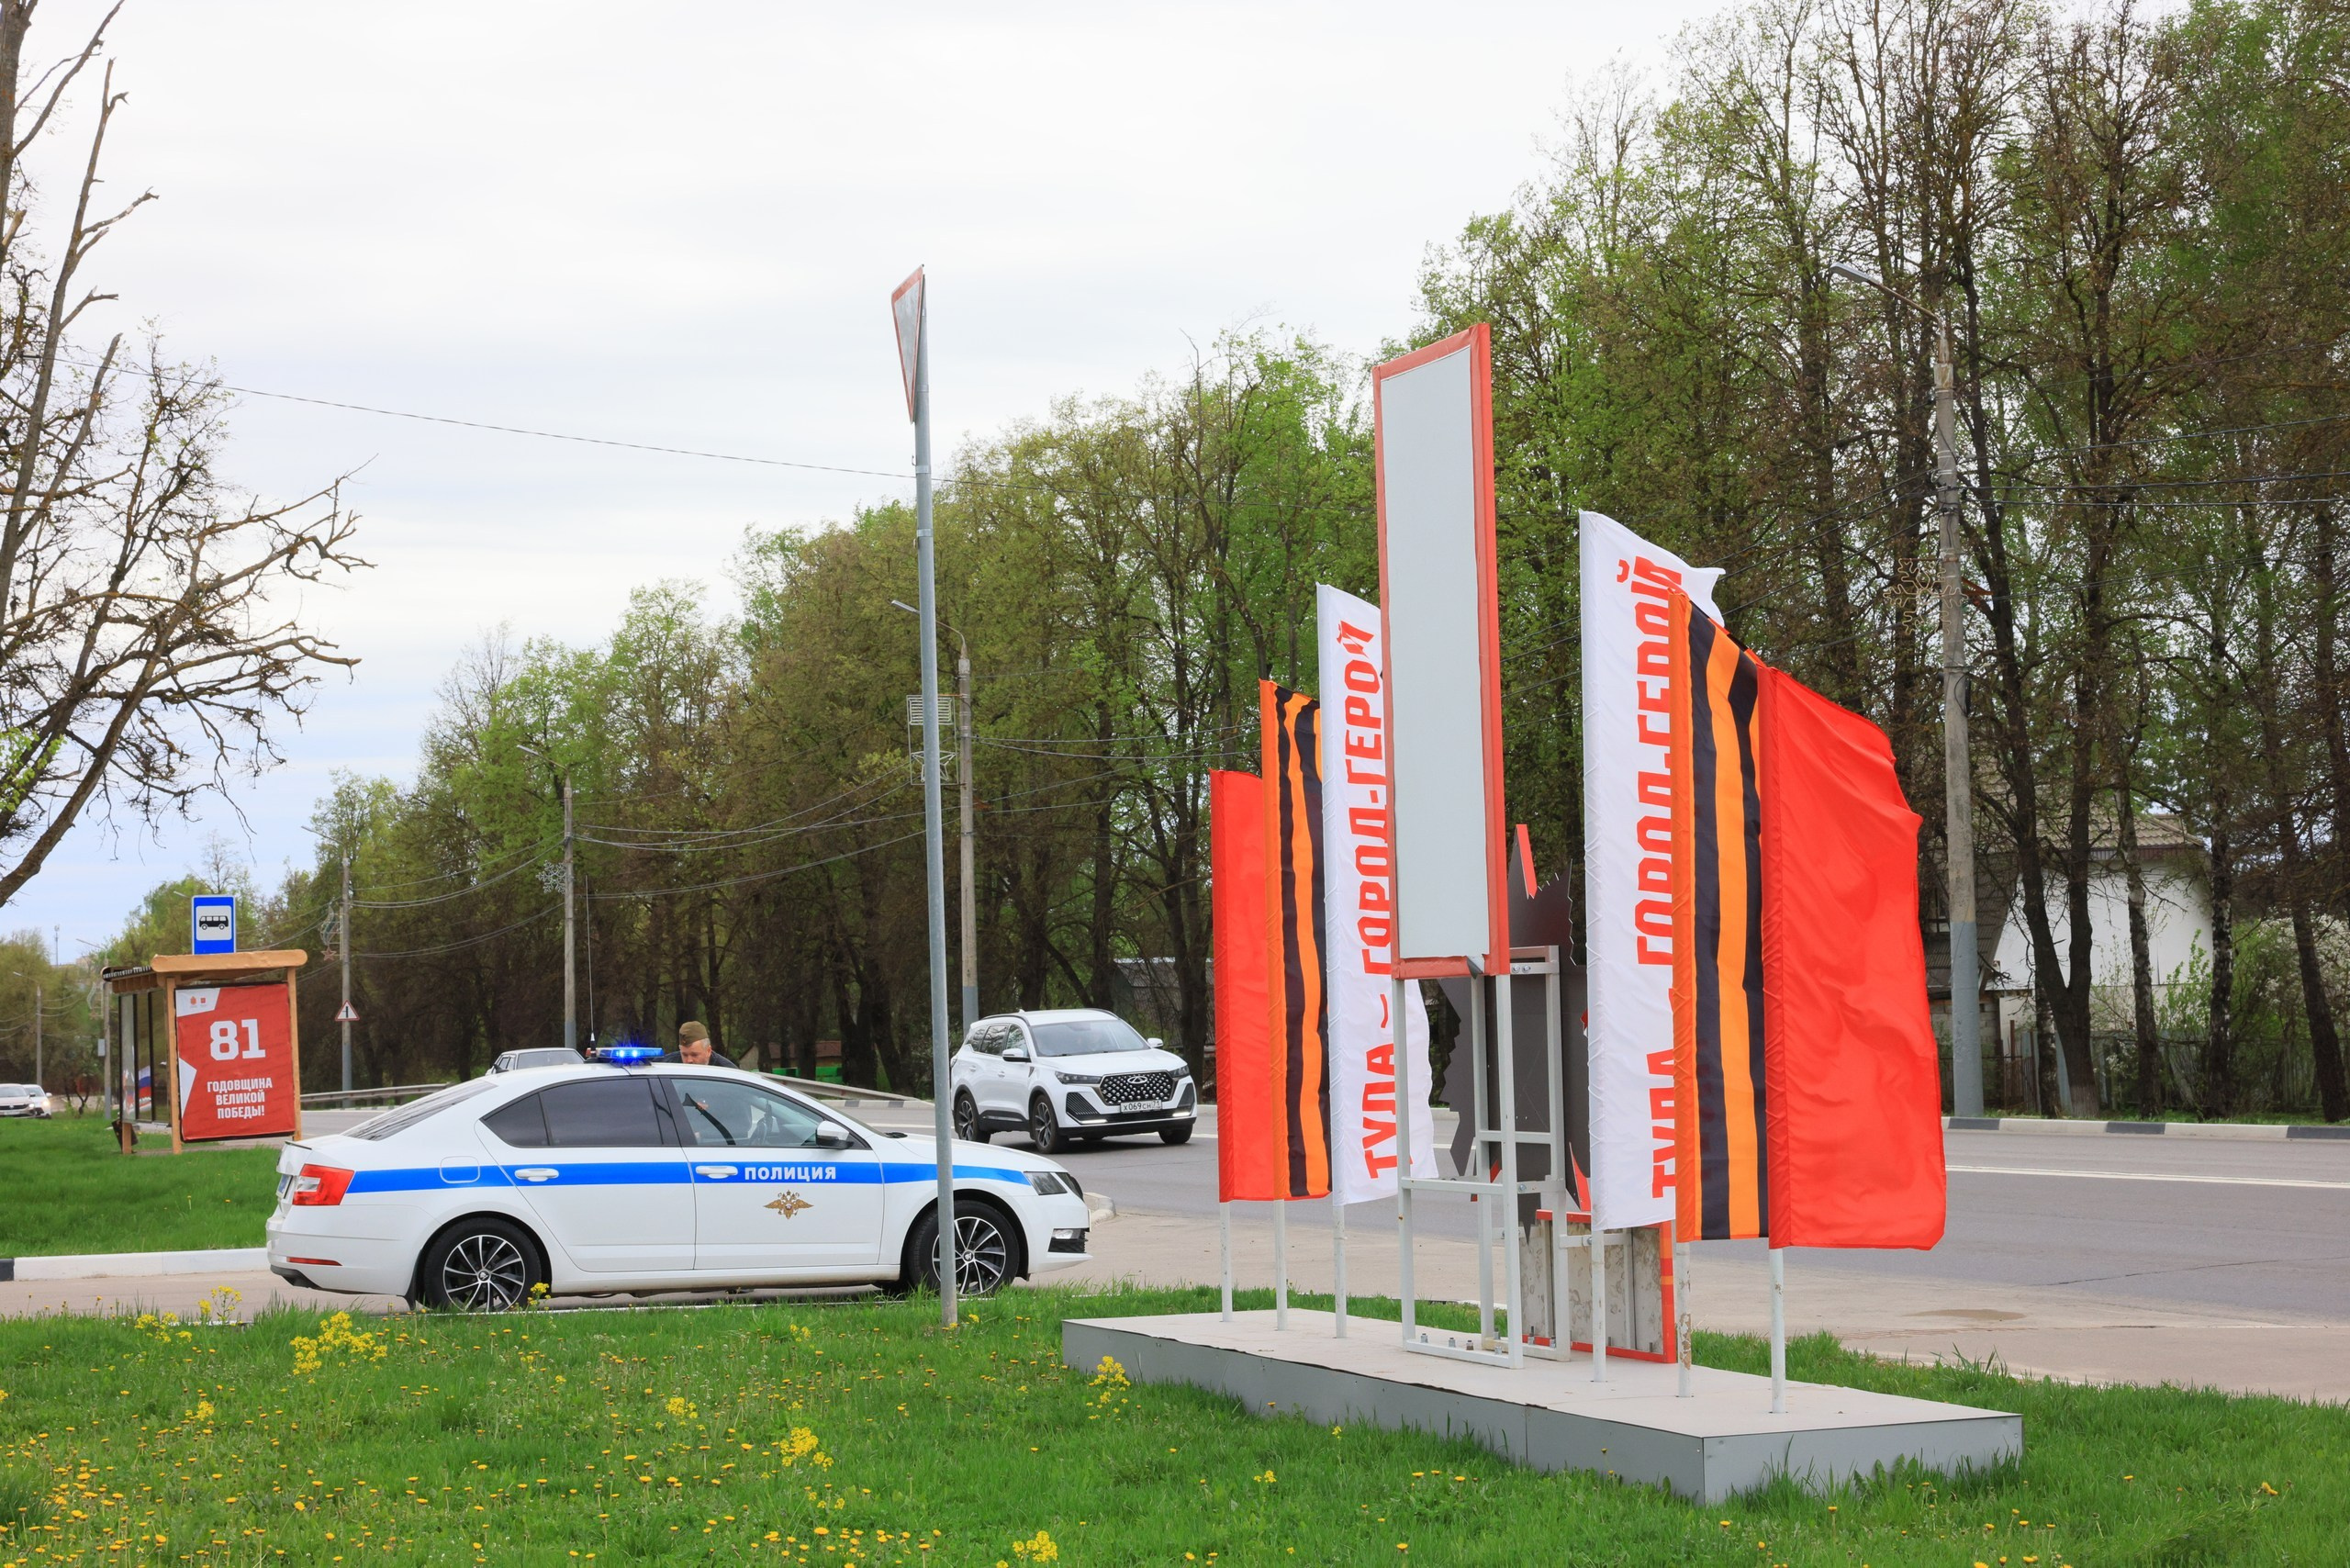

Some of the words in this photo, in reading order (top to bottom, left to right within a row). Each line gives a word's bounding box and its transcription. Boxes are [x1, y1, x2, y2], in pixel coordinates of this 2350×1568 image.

[1337, 620, 1393, 975] ГОРОД-ГЕРОЙ
[209, 1018, 266, 1060] 81
[207, 1077, 274, 1093] ГОДОВЩИНА
[216, 1089, 265, 1105] ВЕЛИКОЙ
[217, 1104, 265, 1120] ПОБЕДЫ!
[1361, 1043, 1403, 1179] ТУЛА
[744, 1166, 836, 1182] ПОЛИЦИЯ
